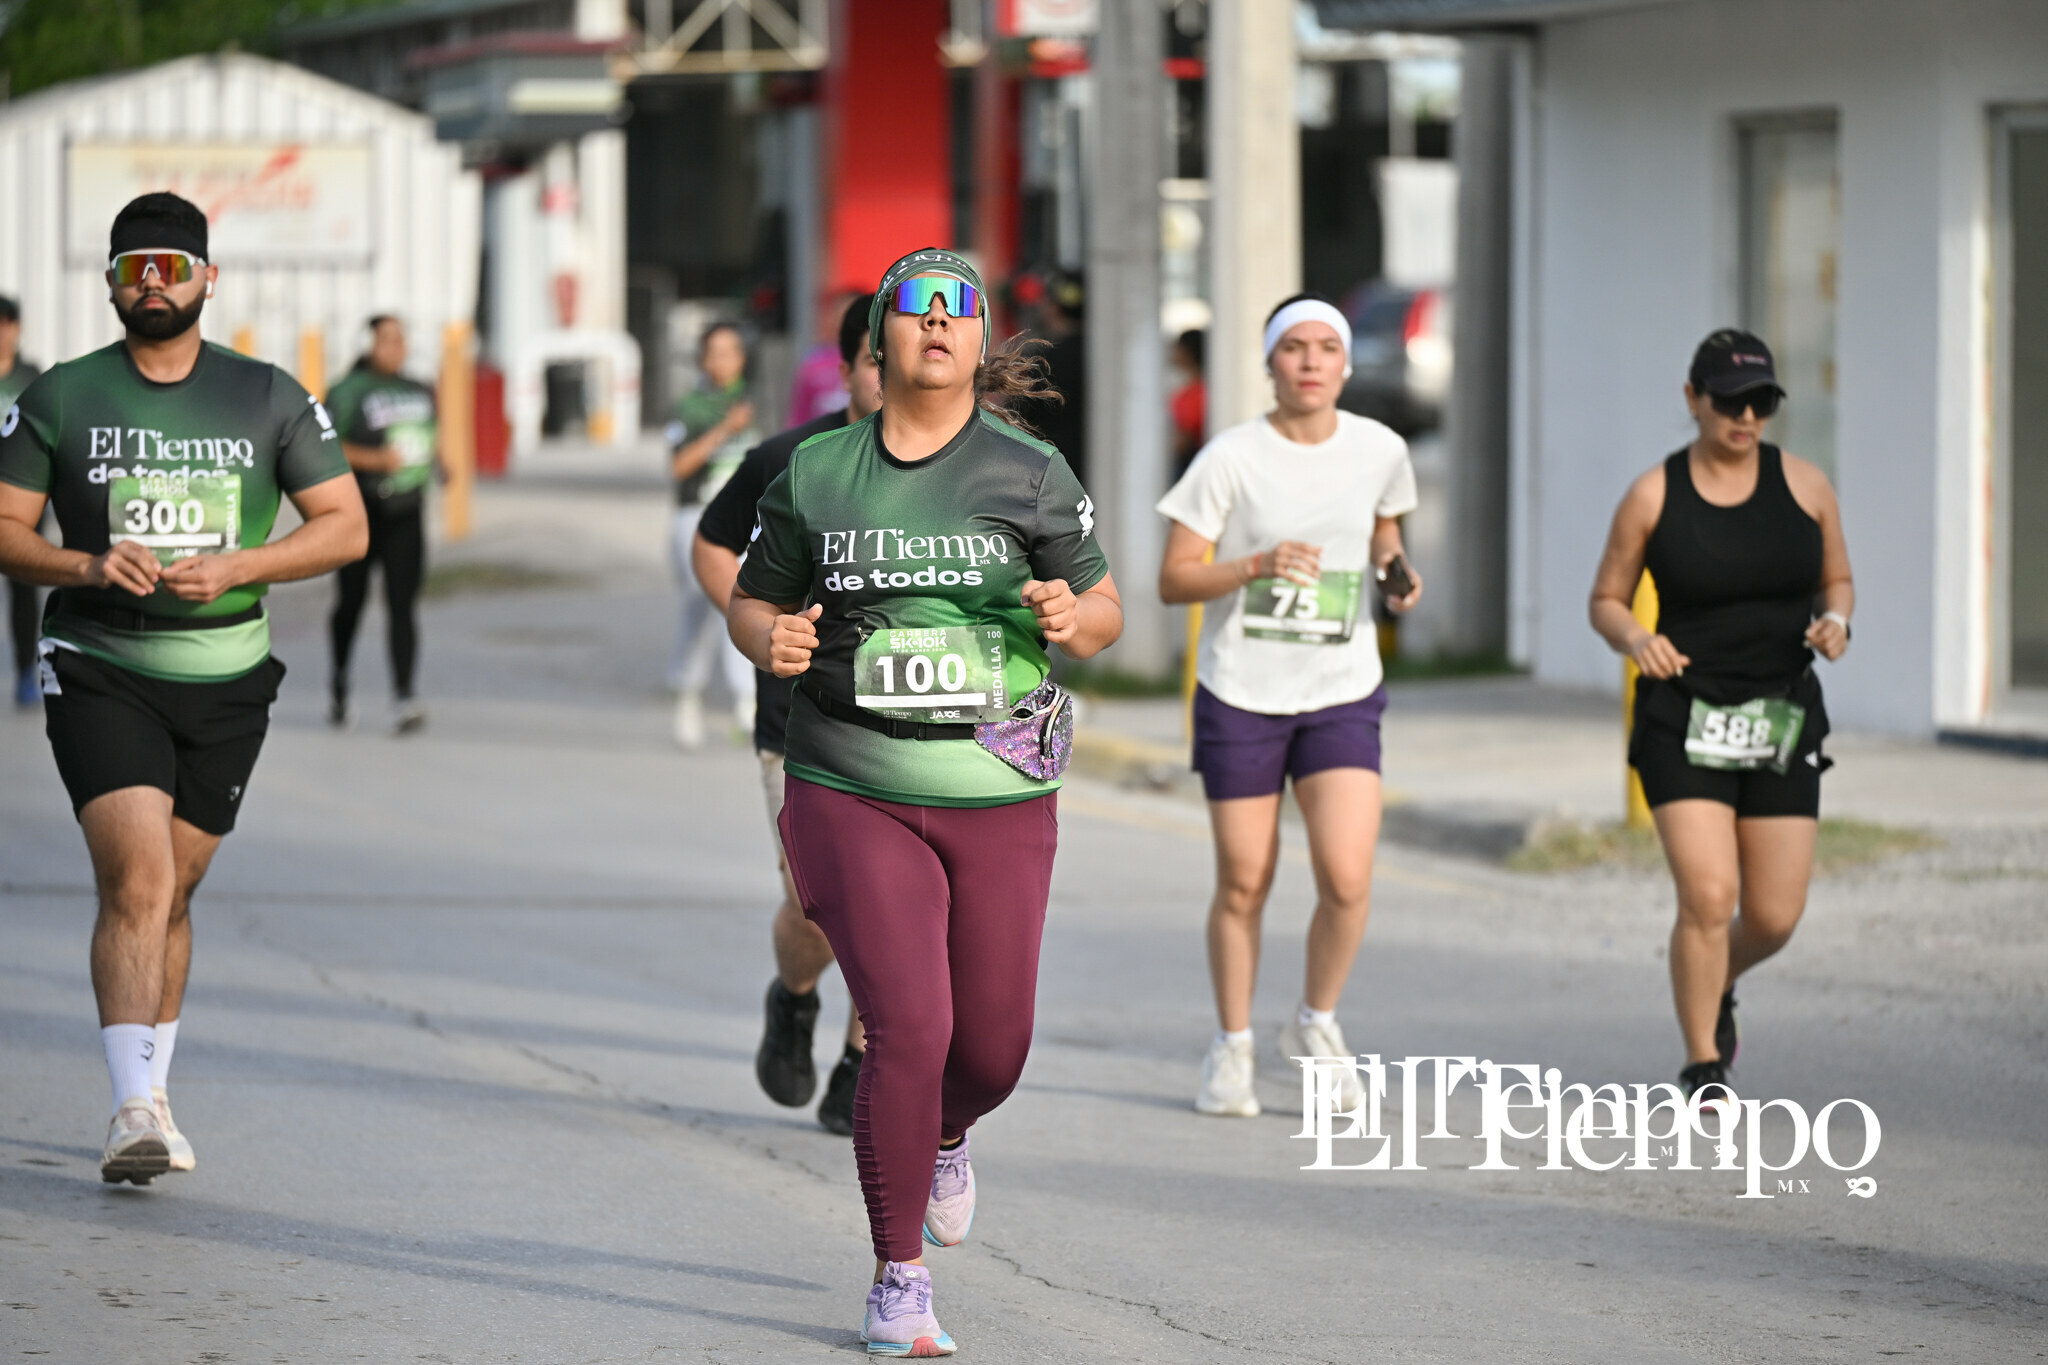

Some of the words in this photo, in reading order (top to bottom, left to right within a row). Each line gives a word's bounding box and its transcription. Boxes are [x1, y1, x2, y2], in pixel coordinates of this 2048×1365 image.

[88, 426, 123, 460] El
[127, 427, 253, 468] Tiempo
[88, 463, 128, 484] de
[124, 498, 205, 534] 300
[821, 530, 857, 565] El
[864, 528, 1007, 567] Tiempo
[825, 571, 865, 592] de
[869, 566, 984, 589] todos
[1270, 586, 1320, 620] 75
[889, 629, 947, 638] CARRERA
[986, 630, 1002, 639] 100
[876, 653, 967, 694] 100
[990, 645, 1004, 709] MEDALLA
[1702, 710, 1772, 747] 588
